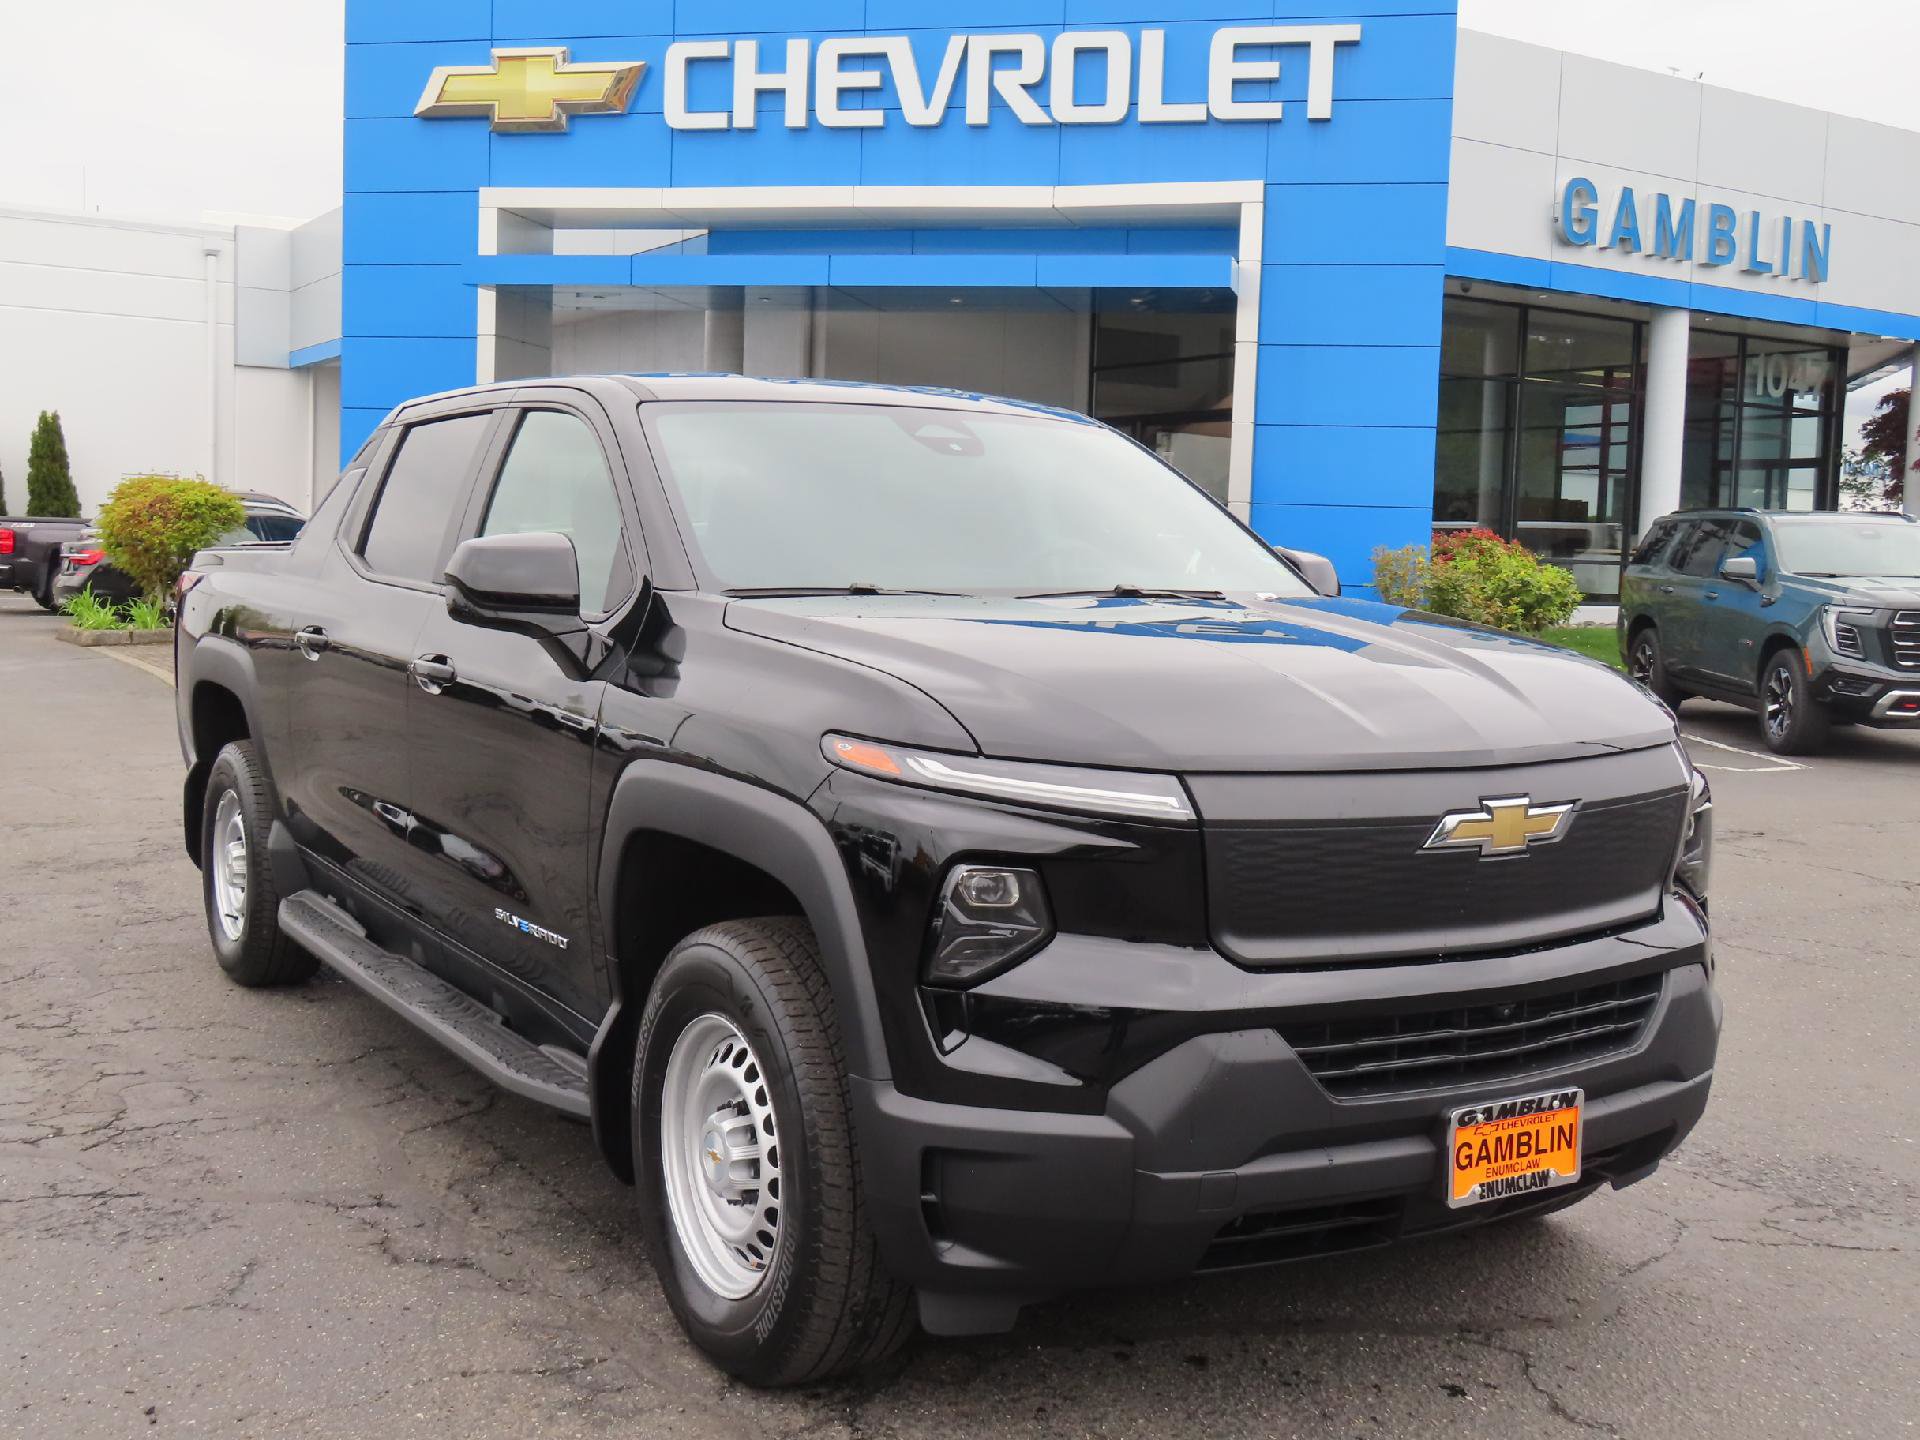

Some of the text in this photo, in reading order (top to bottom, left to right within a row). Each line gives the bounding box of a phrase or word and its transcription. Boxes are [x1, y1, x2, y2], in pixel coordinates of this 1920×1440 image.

[663, 24, 1361, 130] CHEVROLET
[1558, 177, 1831, 282] GAMBLIN
[494, 907, 569, 950] SILVERADO
[1457, 1091, 1578, 1127] GAMBLIN
[1501, 1113, 1557, 1131] CHEVROLET
[1455, 1122, 1573, 1171] GAMBLIN
[1479, 1168, 1550, 1200] ENUMCLAW
[1485, 1157, 1541, 1178] ENUMCLAW
